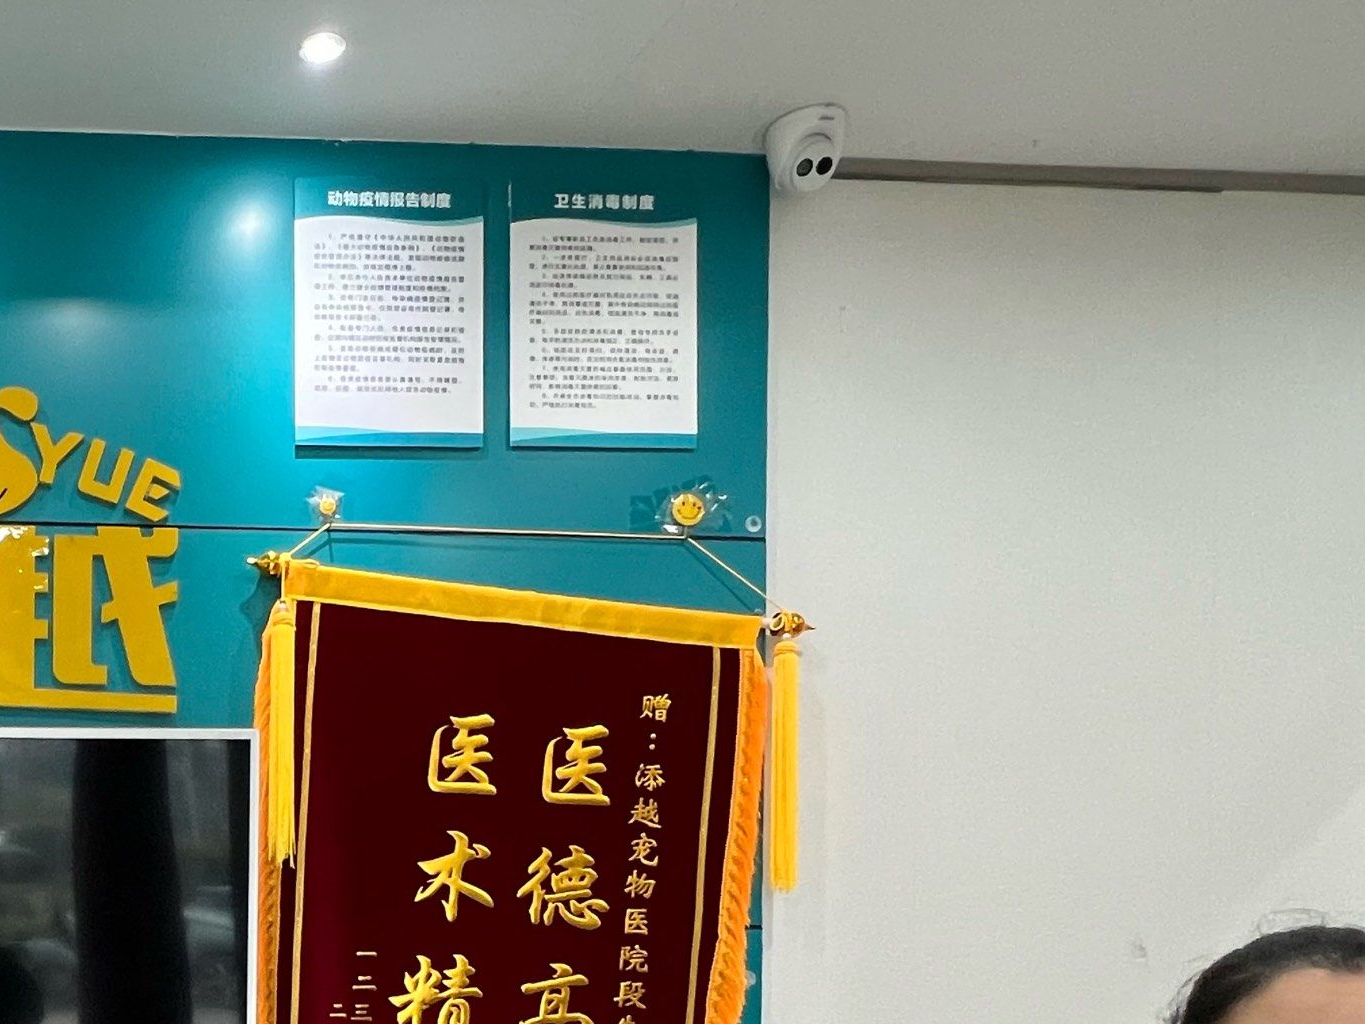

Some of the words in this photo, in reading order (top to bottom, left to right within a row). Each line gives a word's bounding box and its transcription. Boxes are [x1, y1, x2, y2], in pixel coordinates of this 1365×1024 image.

[327, 190, 451, 209] 动物疫情报告制度
[554, 193, 655, 211] 卫生消毒制度
[30, 421, 181, 523] YUE
